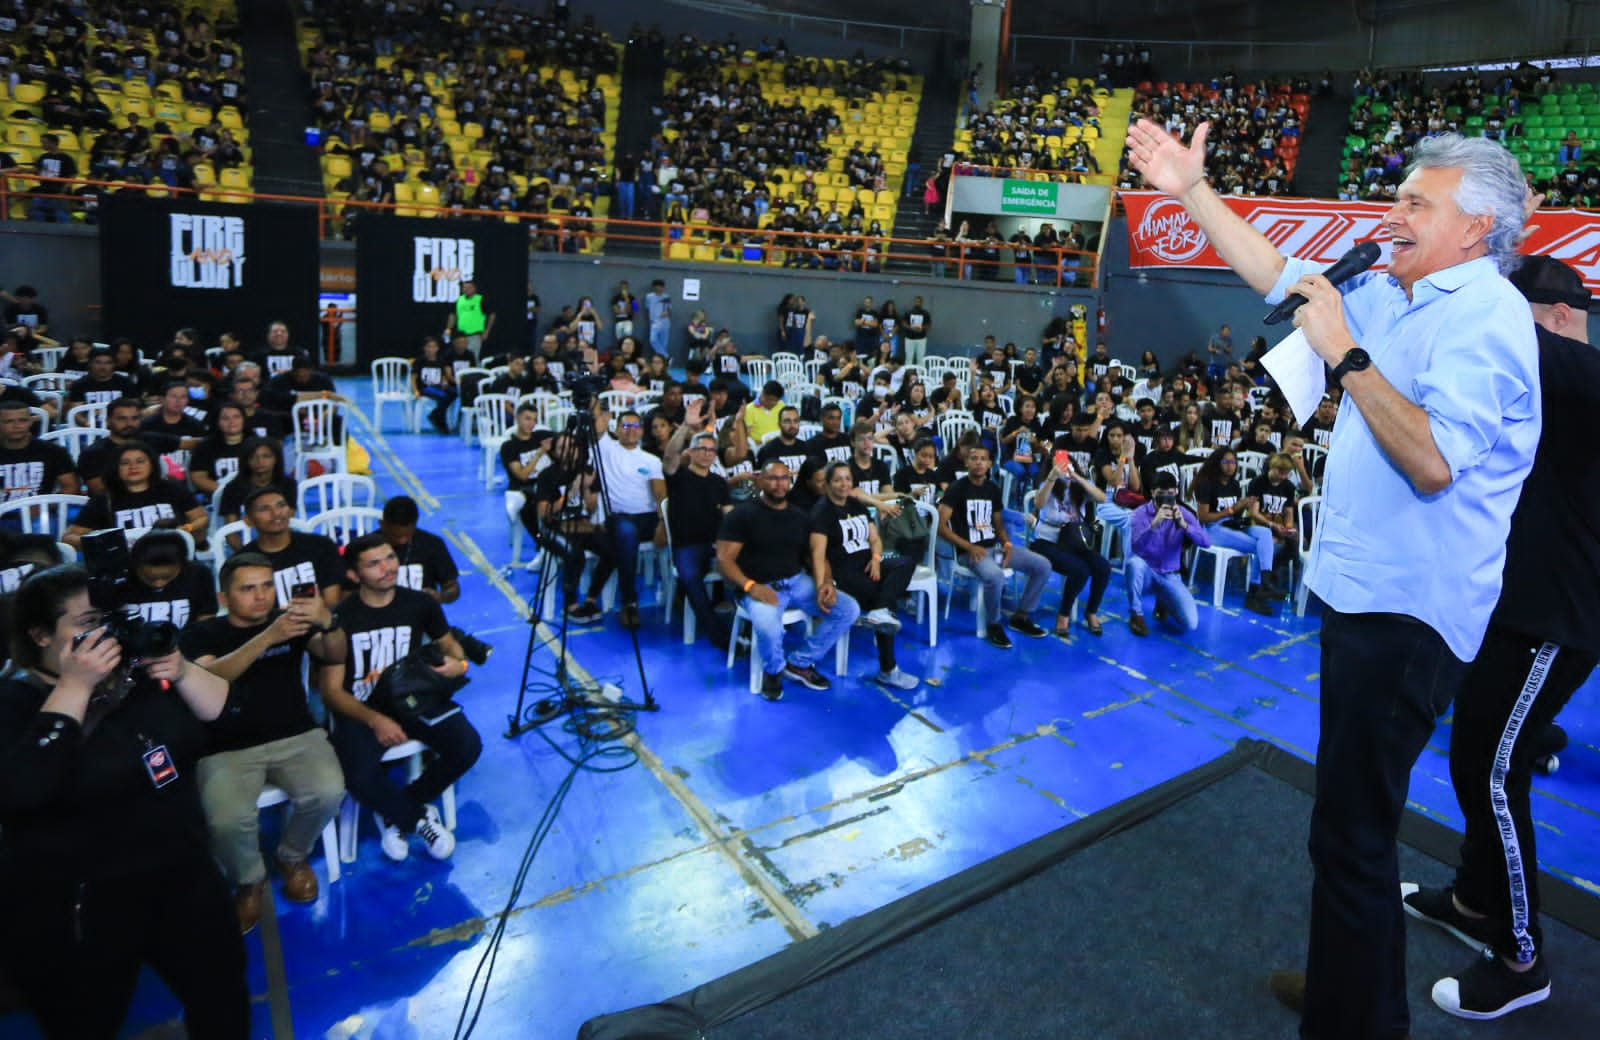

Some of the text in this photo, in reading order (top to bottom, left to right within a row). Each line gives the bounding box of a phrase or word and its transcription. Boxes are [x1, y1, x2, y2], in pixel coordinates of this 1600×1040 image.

[1002, 196, 1056, 208] EMERGÊNCIA
[1011, 186, 1049, 196] SAÍDA DE
[169, 213, 245, 257] FIRE
[414, 236, 475, 275] FIRE
[352, 625, 412, 678] FIRE
[1525, 665, 1545, 694] CLASSIC
[1496, 740, 1512, 768] CLASSIC
